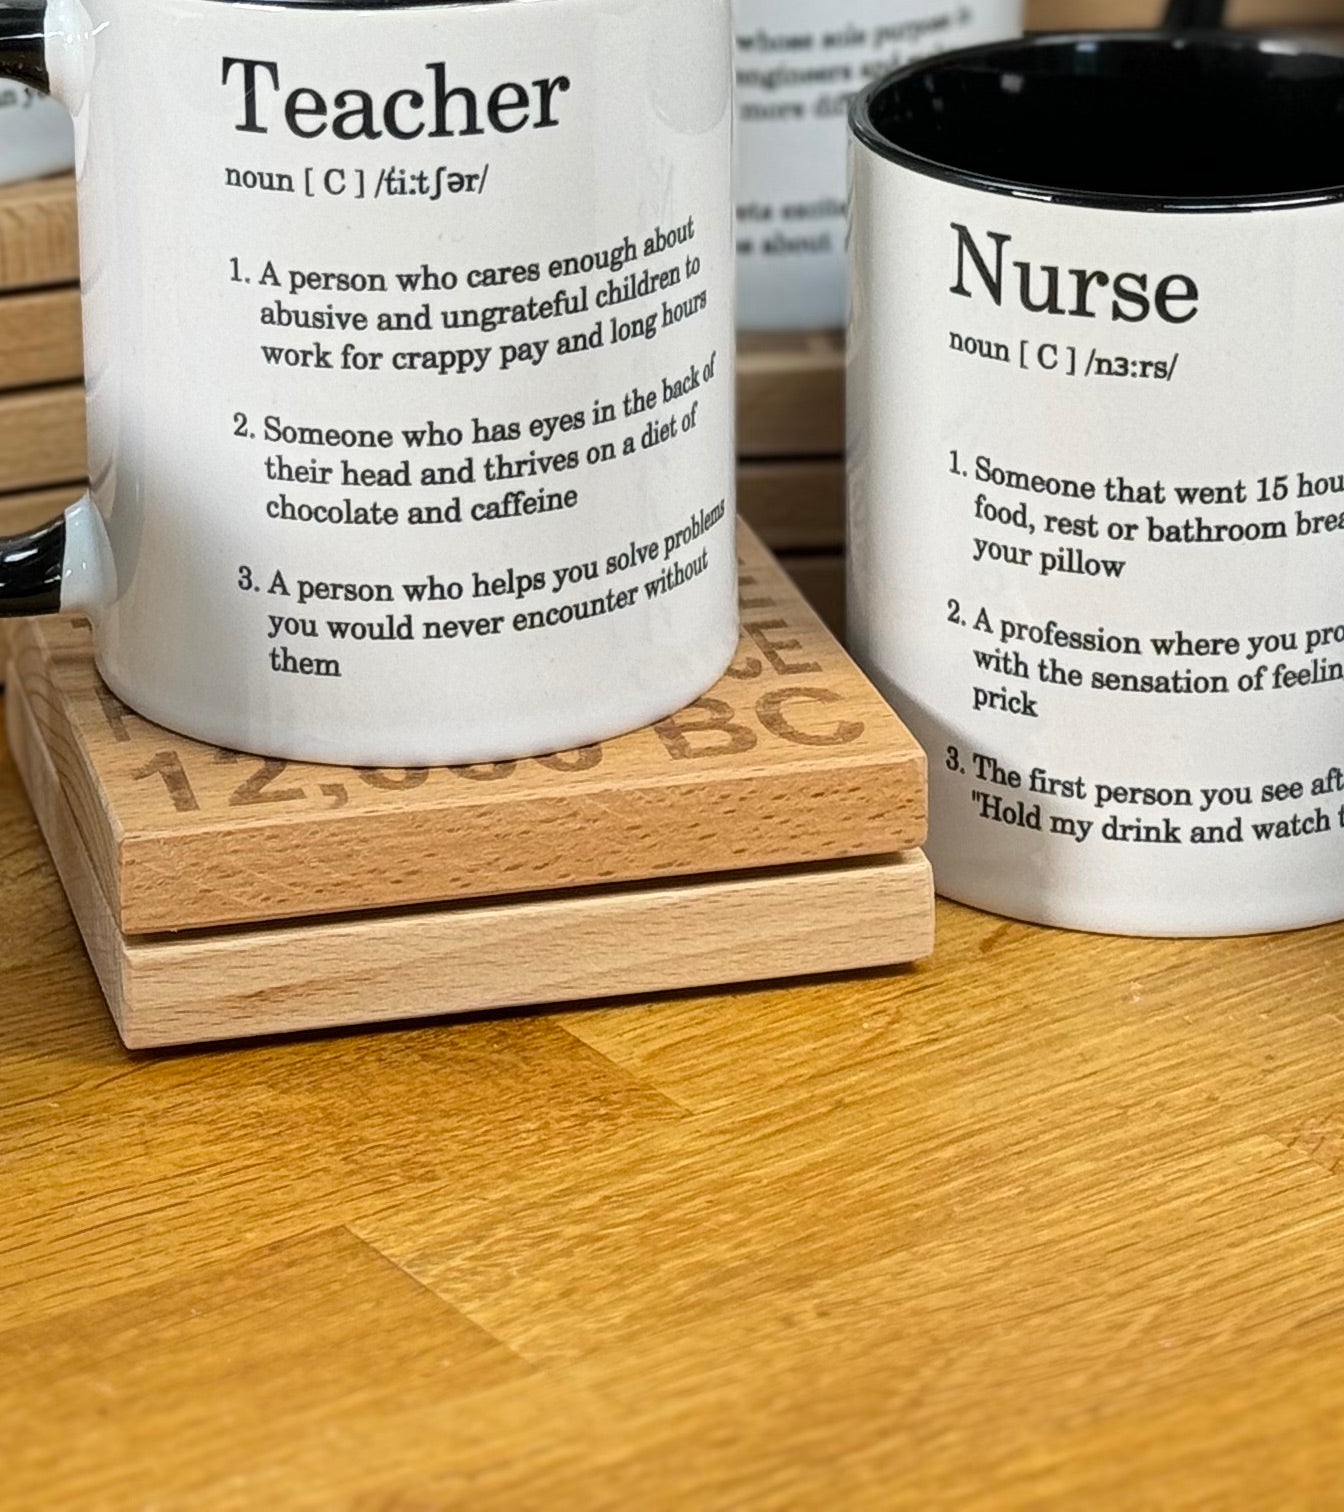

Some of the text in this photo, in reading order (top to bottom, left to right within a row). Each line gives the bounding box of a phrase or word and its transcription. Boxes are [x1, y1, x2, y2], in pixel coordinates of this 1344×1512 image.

[221, 56, 571, 140] Teacher
[225, 167, 294, 193] noun
[230, 215, 695, 294] 1. A person who cares enough about
[950, 222, 1199, 324] Nurse
[260, 255, 701, 331] abusive and ungrateful children to
[262, 289, 707, 375] work for crappy pay and long hours
[950, 331, 1009, 361] noun
[233, 351, 716, 448] 2. Someone who has eyes in the back of
[949, 451, 967, 476] 1.
[975, 457, 1096, 499] Someone
[1105, 475, 1166, 506] that
[1175, 477, 1247, 505] went
[1256, 475, 1288, 502] 15
[974, 495, 1035, 535] food,
[1044, 510, 1098, 539] rest
[1108, 517, 1139, 542] or
[1147, 514, 1287, 543] bathroom
[973, 535, 1126, 579] your pillow
[657, 687, 865, 760] BC
[946, 746, 965, 774] 3.
[973, 753, 1021, 787] The
[1029, 767, 1085, 799] first
[1095, 777, 1192, 808] person
[1201, 783, 1252, 811] you
[1261, 777, 1303, 802] see
[972, 790, 1042, 831] "Hold
[1049, 815, 1094, 841] my
[1102, 815, 1181, 844] drink
[1190, 817, 1243, 843] and
[1252, 808, 1330, 840] watch
